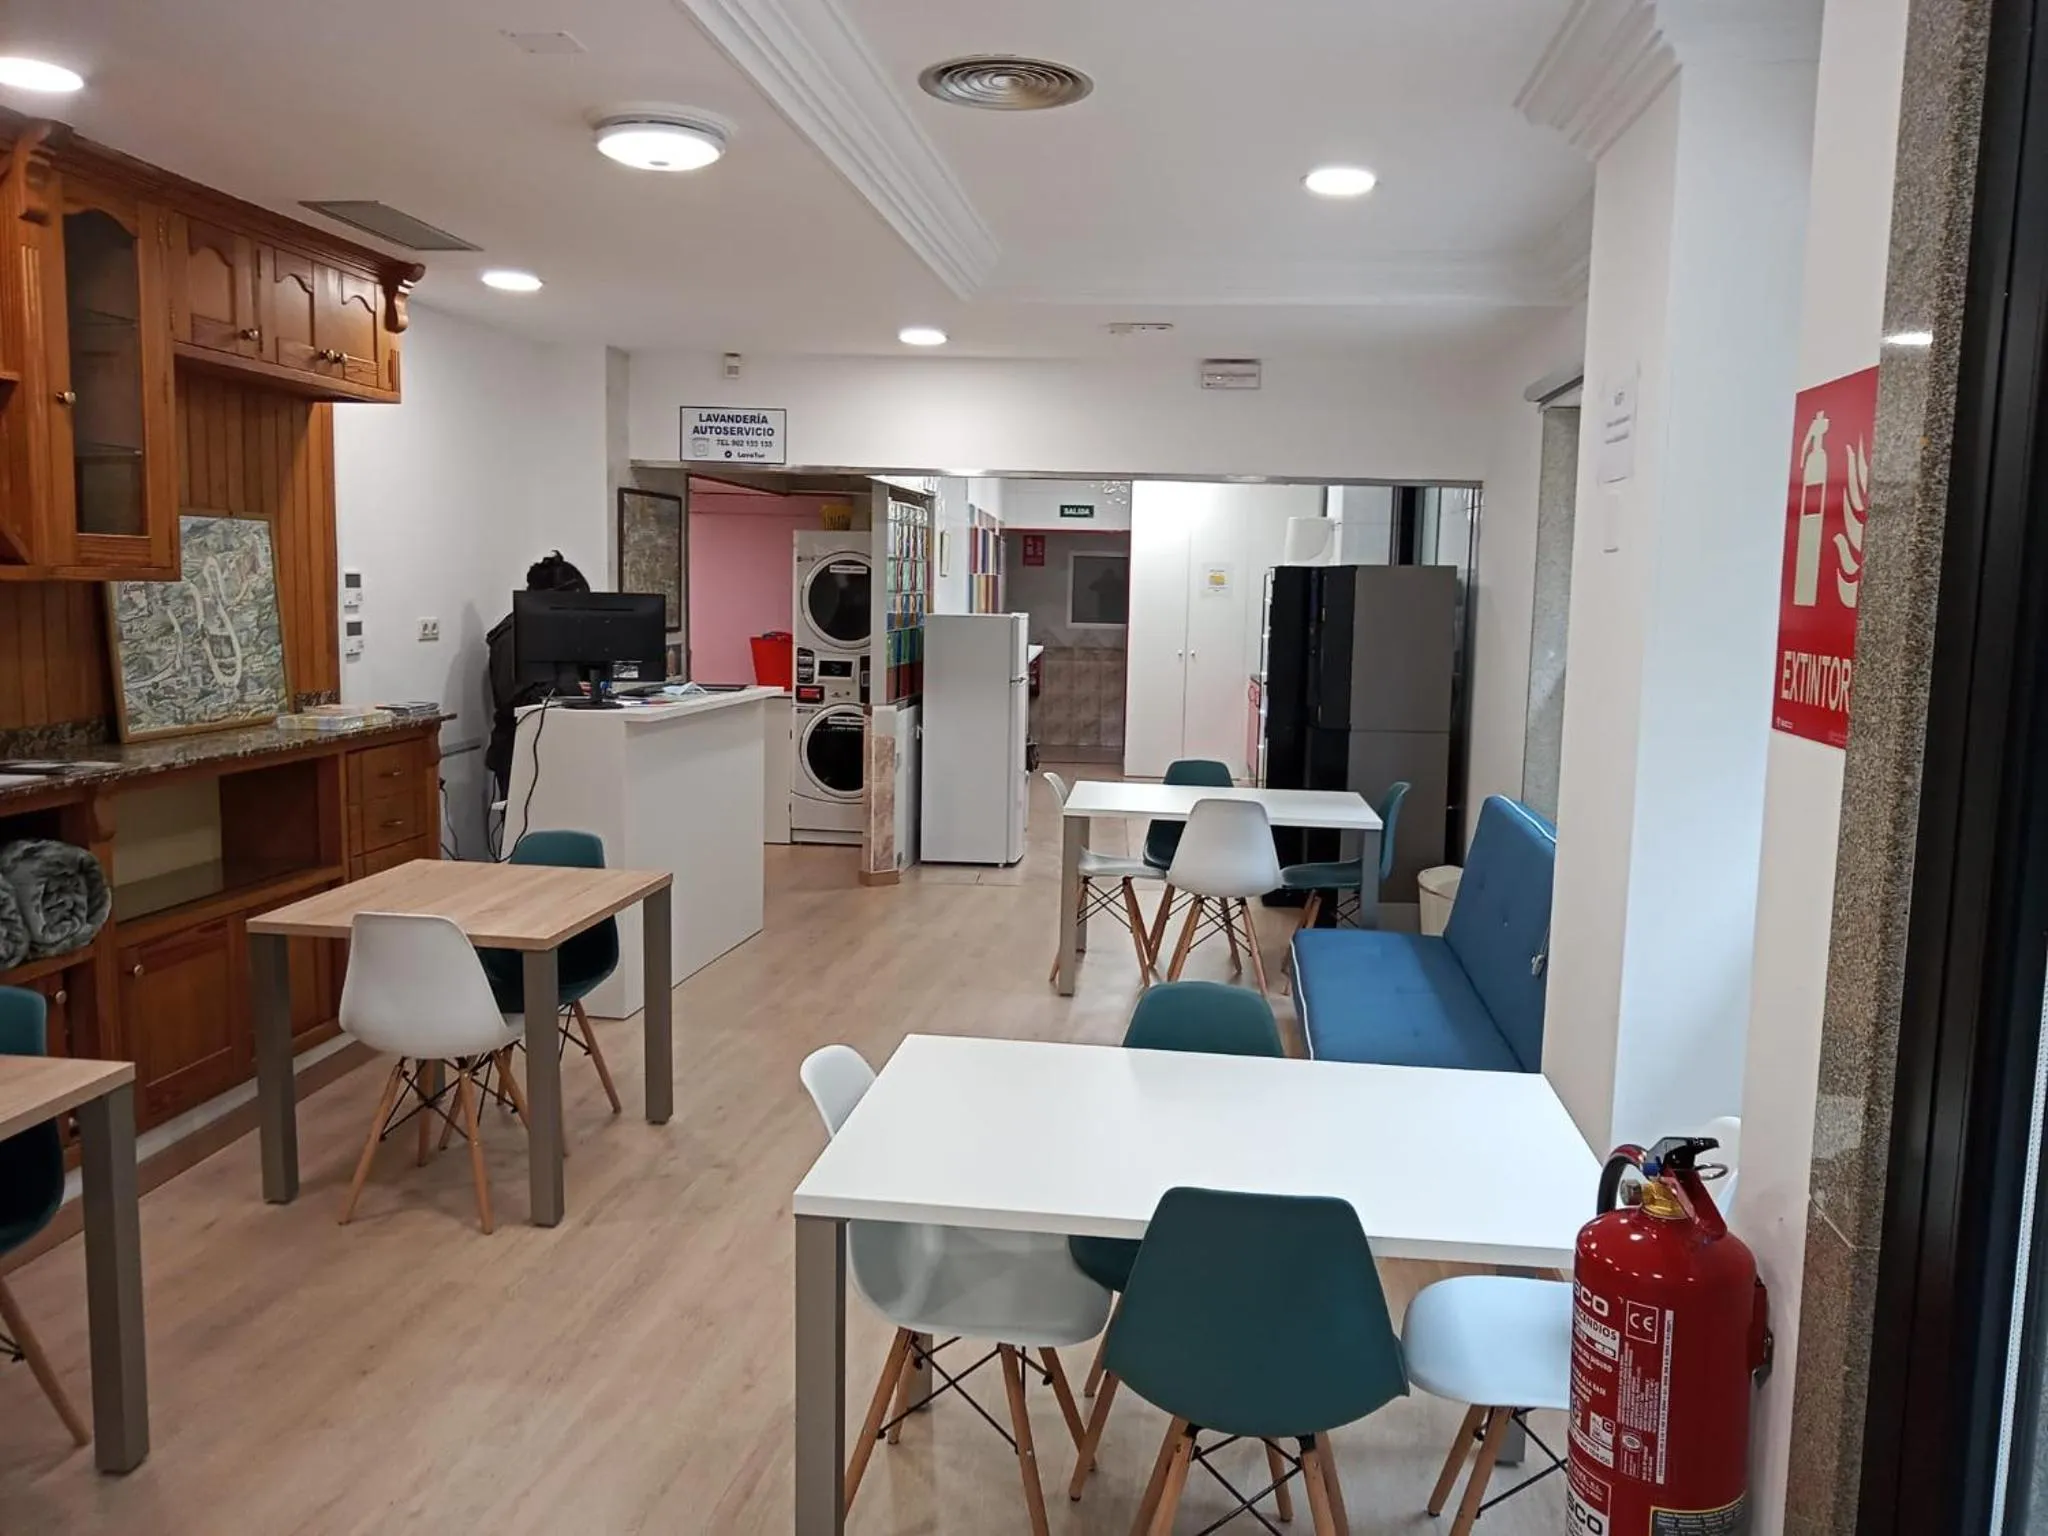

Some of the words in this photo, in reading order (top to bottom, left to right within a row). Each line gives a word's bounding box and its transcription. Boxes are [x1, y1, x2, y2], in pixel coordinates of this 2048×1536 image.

[698, 413, 768, 424] LAVANDERÍA
[692, 425, 775, 437] AUTOSERVICIO
[1781, 650, 1852, 713] EXTINTOR
[1630, 1313, 1654, 1332] CE
